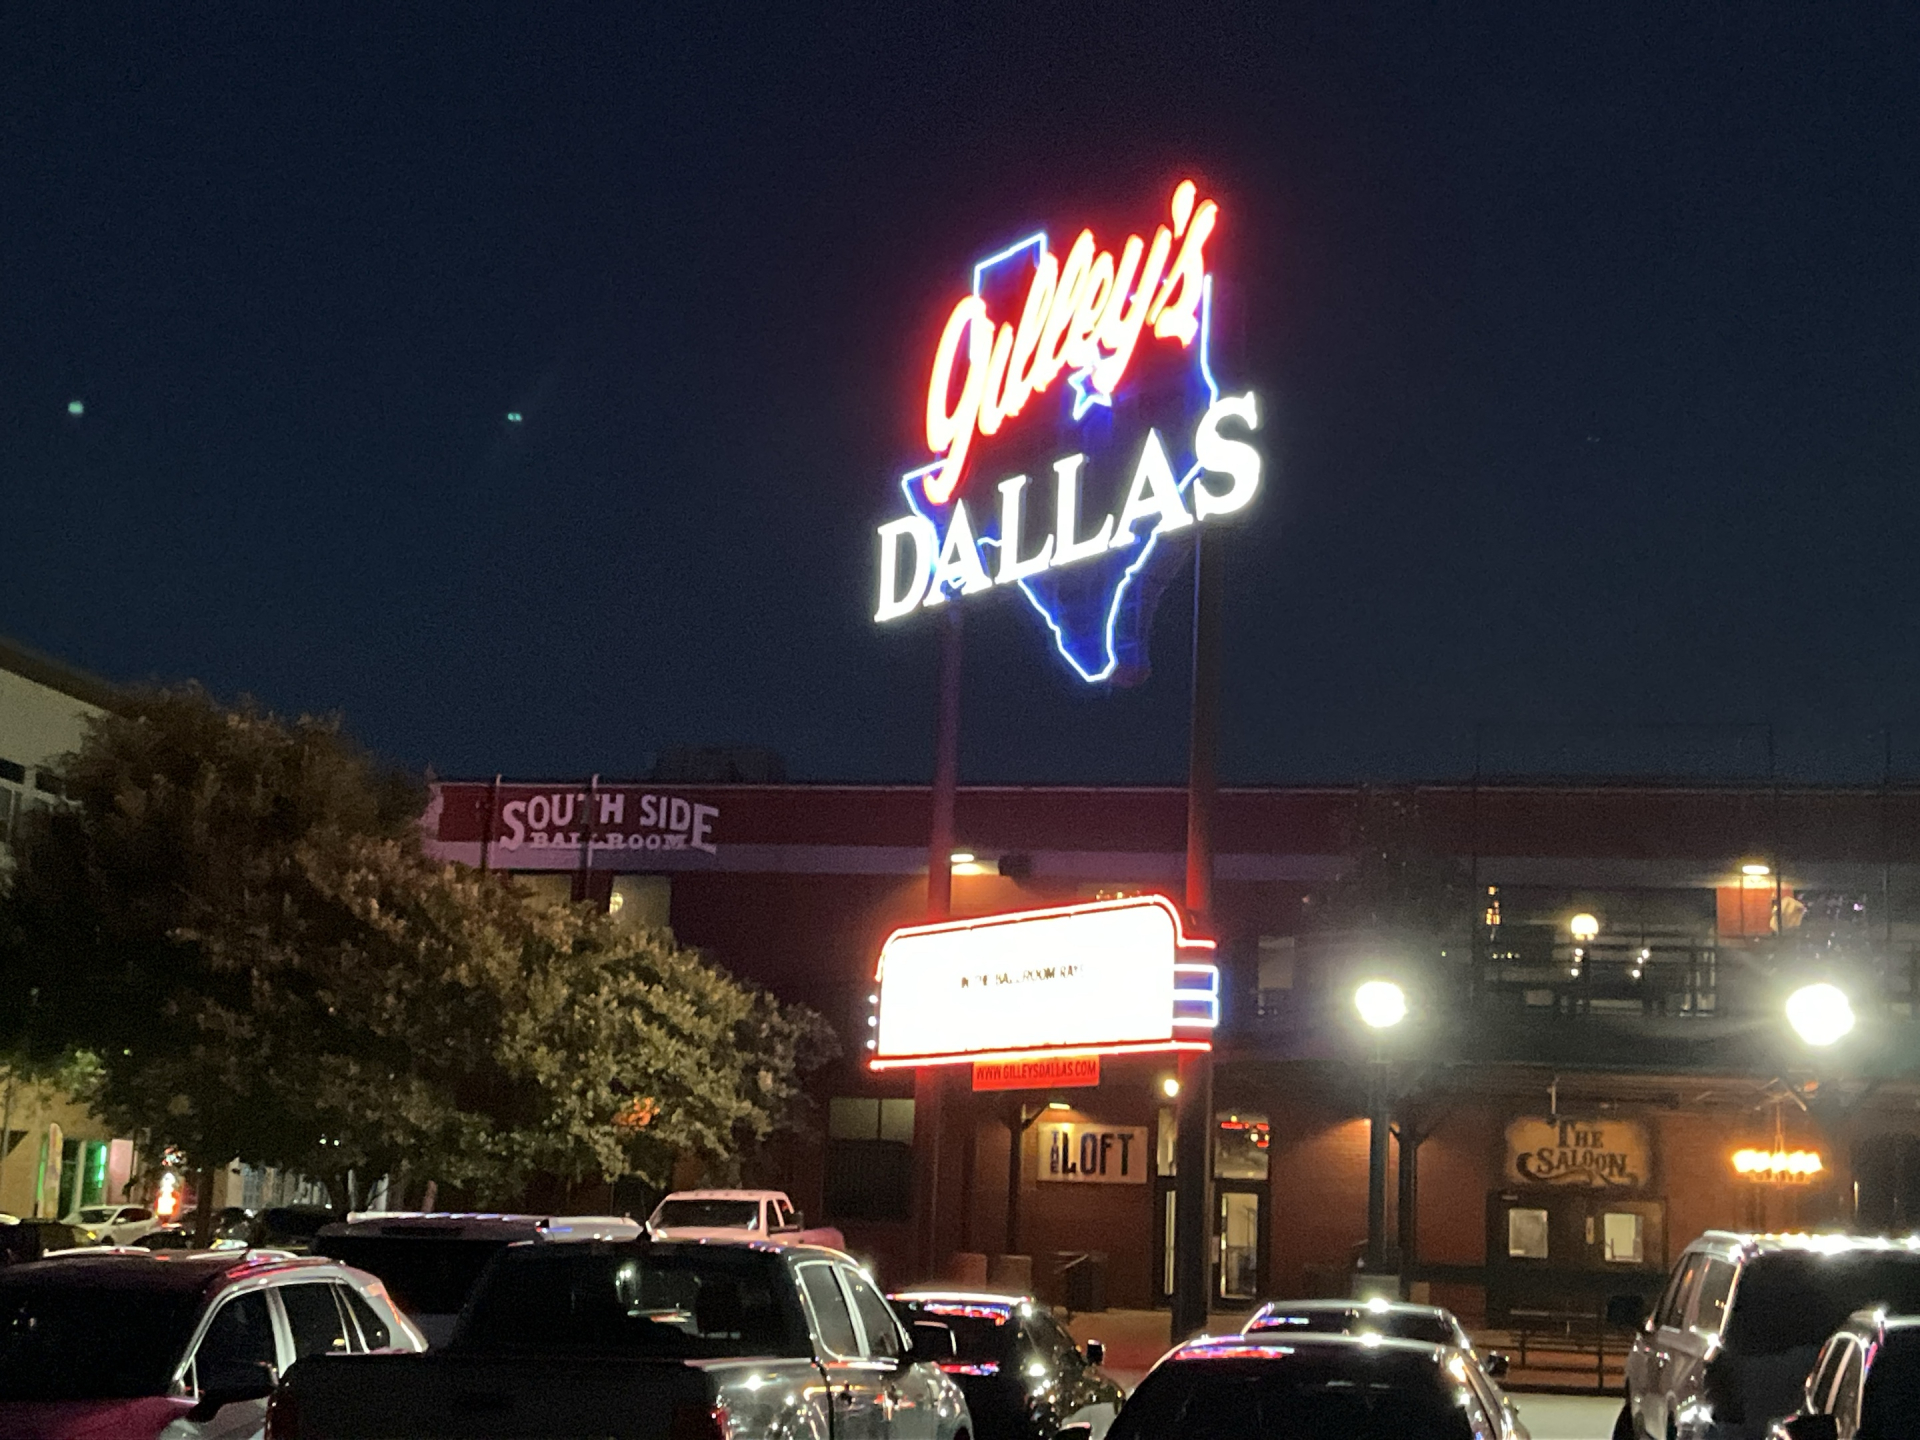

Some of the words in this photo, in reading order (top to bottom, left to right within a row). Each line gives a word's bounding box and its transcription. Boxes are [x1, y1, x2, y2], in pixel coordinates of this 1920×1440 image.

[923, 179, 1219, 506] Gilley's
[874, 391, 1261, 623] DALLAS
[639, 794, 719, 854] SIDE
[995, 966, 1056, 986] BAROOM
[976, 1060, 1097, 1080] WWWGILLEYSDALLASCOM
[1551, 1119, 1604, 1149] THE
[1062, 1131, 1134, 1176] LOFT
[1535, 1147, 1628, 1178] SALOON
